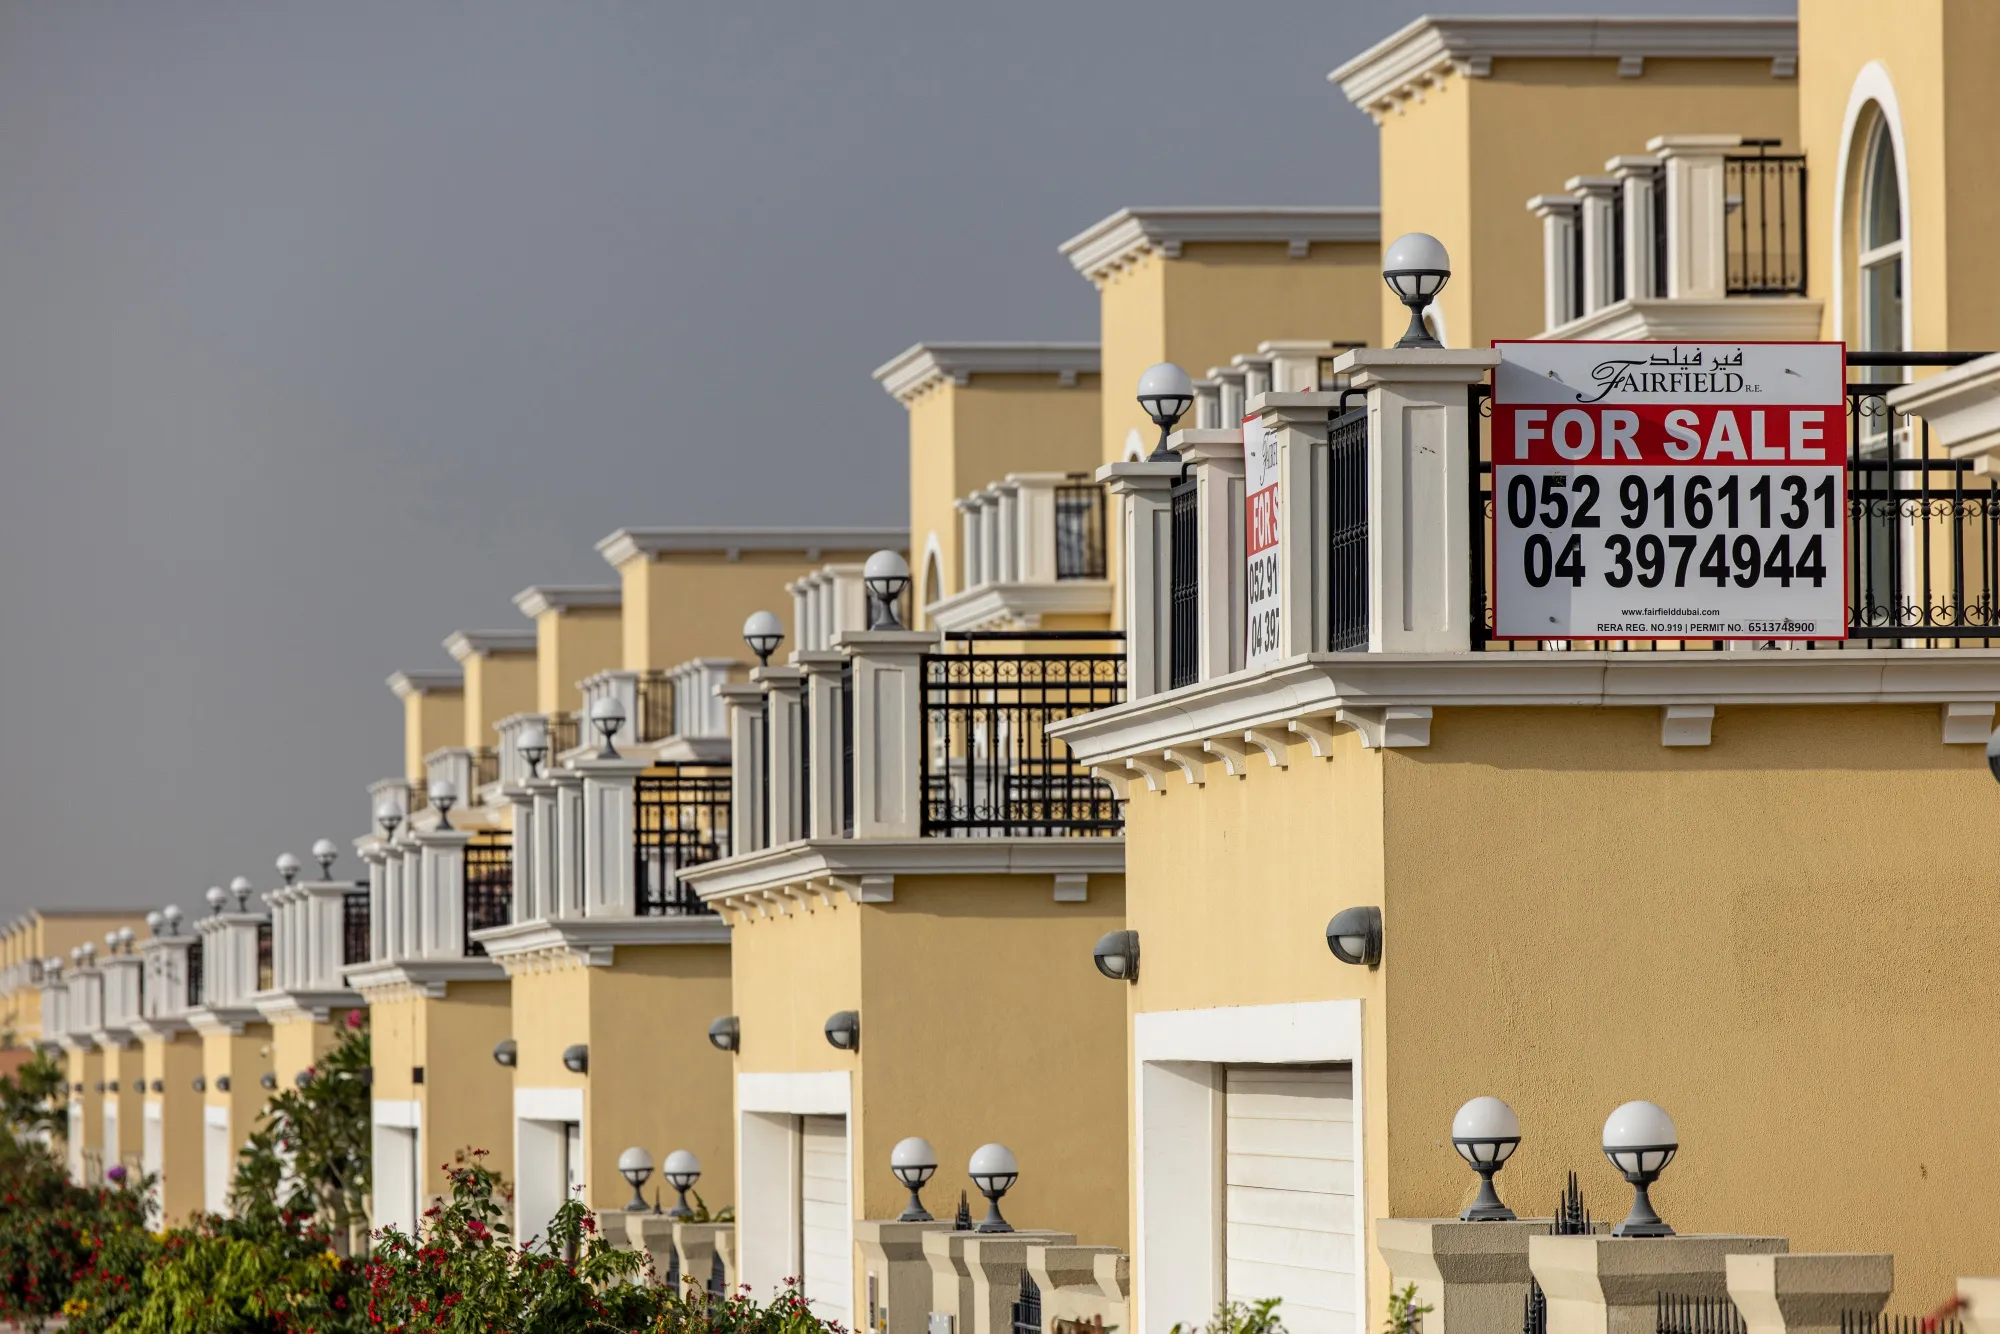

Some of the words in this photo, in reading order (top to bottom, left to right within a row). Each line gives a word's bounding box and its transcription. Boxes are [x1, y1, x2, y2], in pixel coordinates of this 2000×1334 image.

[1649, 346, 1702, 371] فيلد
[1709, 347, 1743, 372] فير
[1575, 360, 1744, 403] FAIRFIELD
[1745, 384, 1762, 393] R.E.
[1514, 409, 1643, 461] FOR
[1663, 409, 1826, 461] SALE
[1253, 491, 1272, 551] FOR
[1507, 474, 1601, 529] 052
[1619, 474, 1835, 529] 9161131
[1249, 559, 1265, 604] 052
[1523, 533, 1586, 588] 04
[1603, 533, 1827, 588] 3974944
[1597, 623, 1624, 632] RERA
[1625, 623, 1649, 632] REG.
[1650, 623, 1684, 632] NO.919
[1690, 623, 1726, 632] PERMIT
[1727, 623, 1744, 632] NO.
[1748, 622, 1815, 633] 6513748900
[1621, 607, 1720, 617] www.fairfielddubai.com
[1251, 613, 1262, 657] 04
